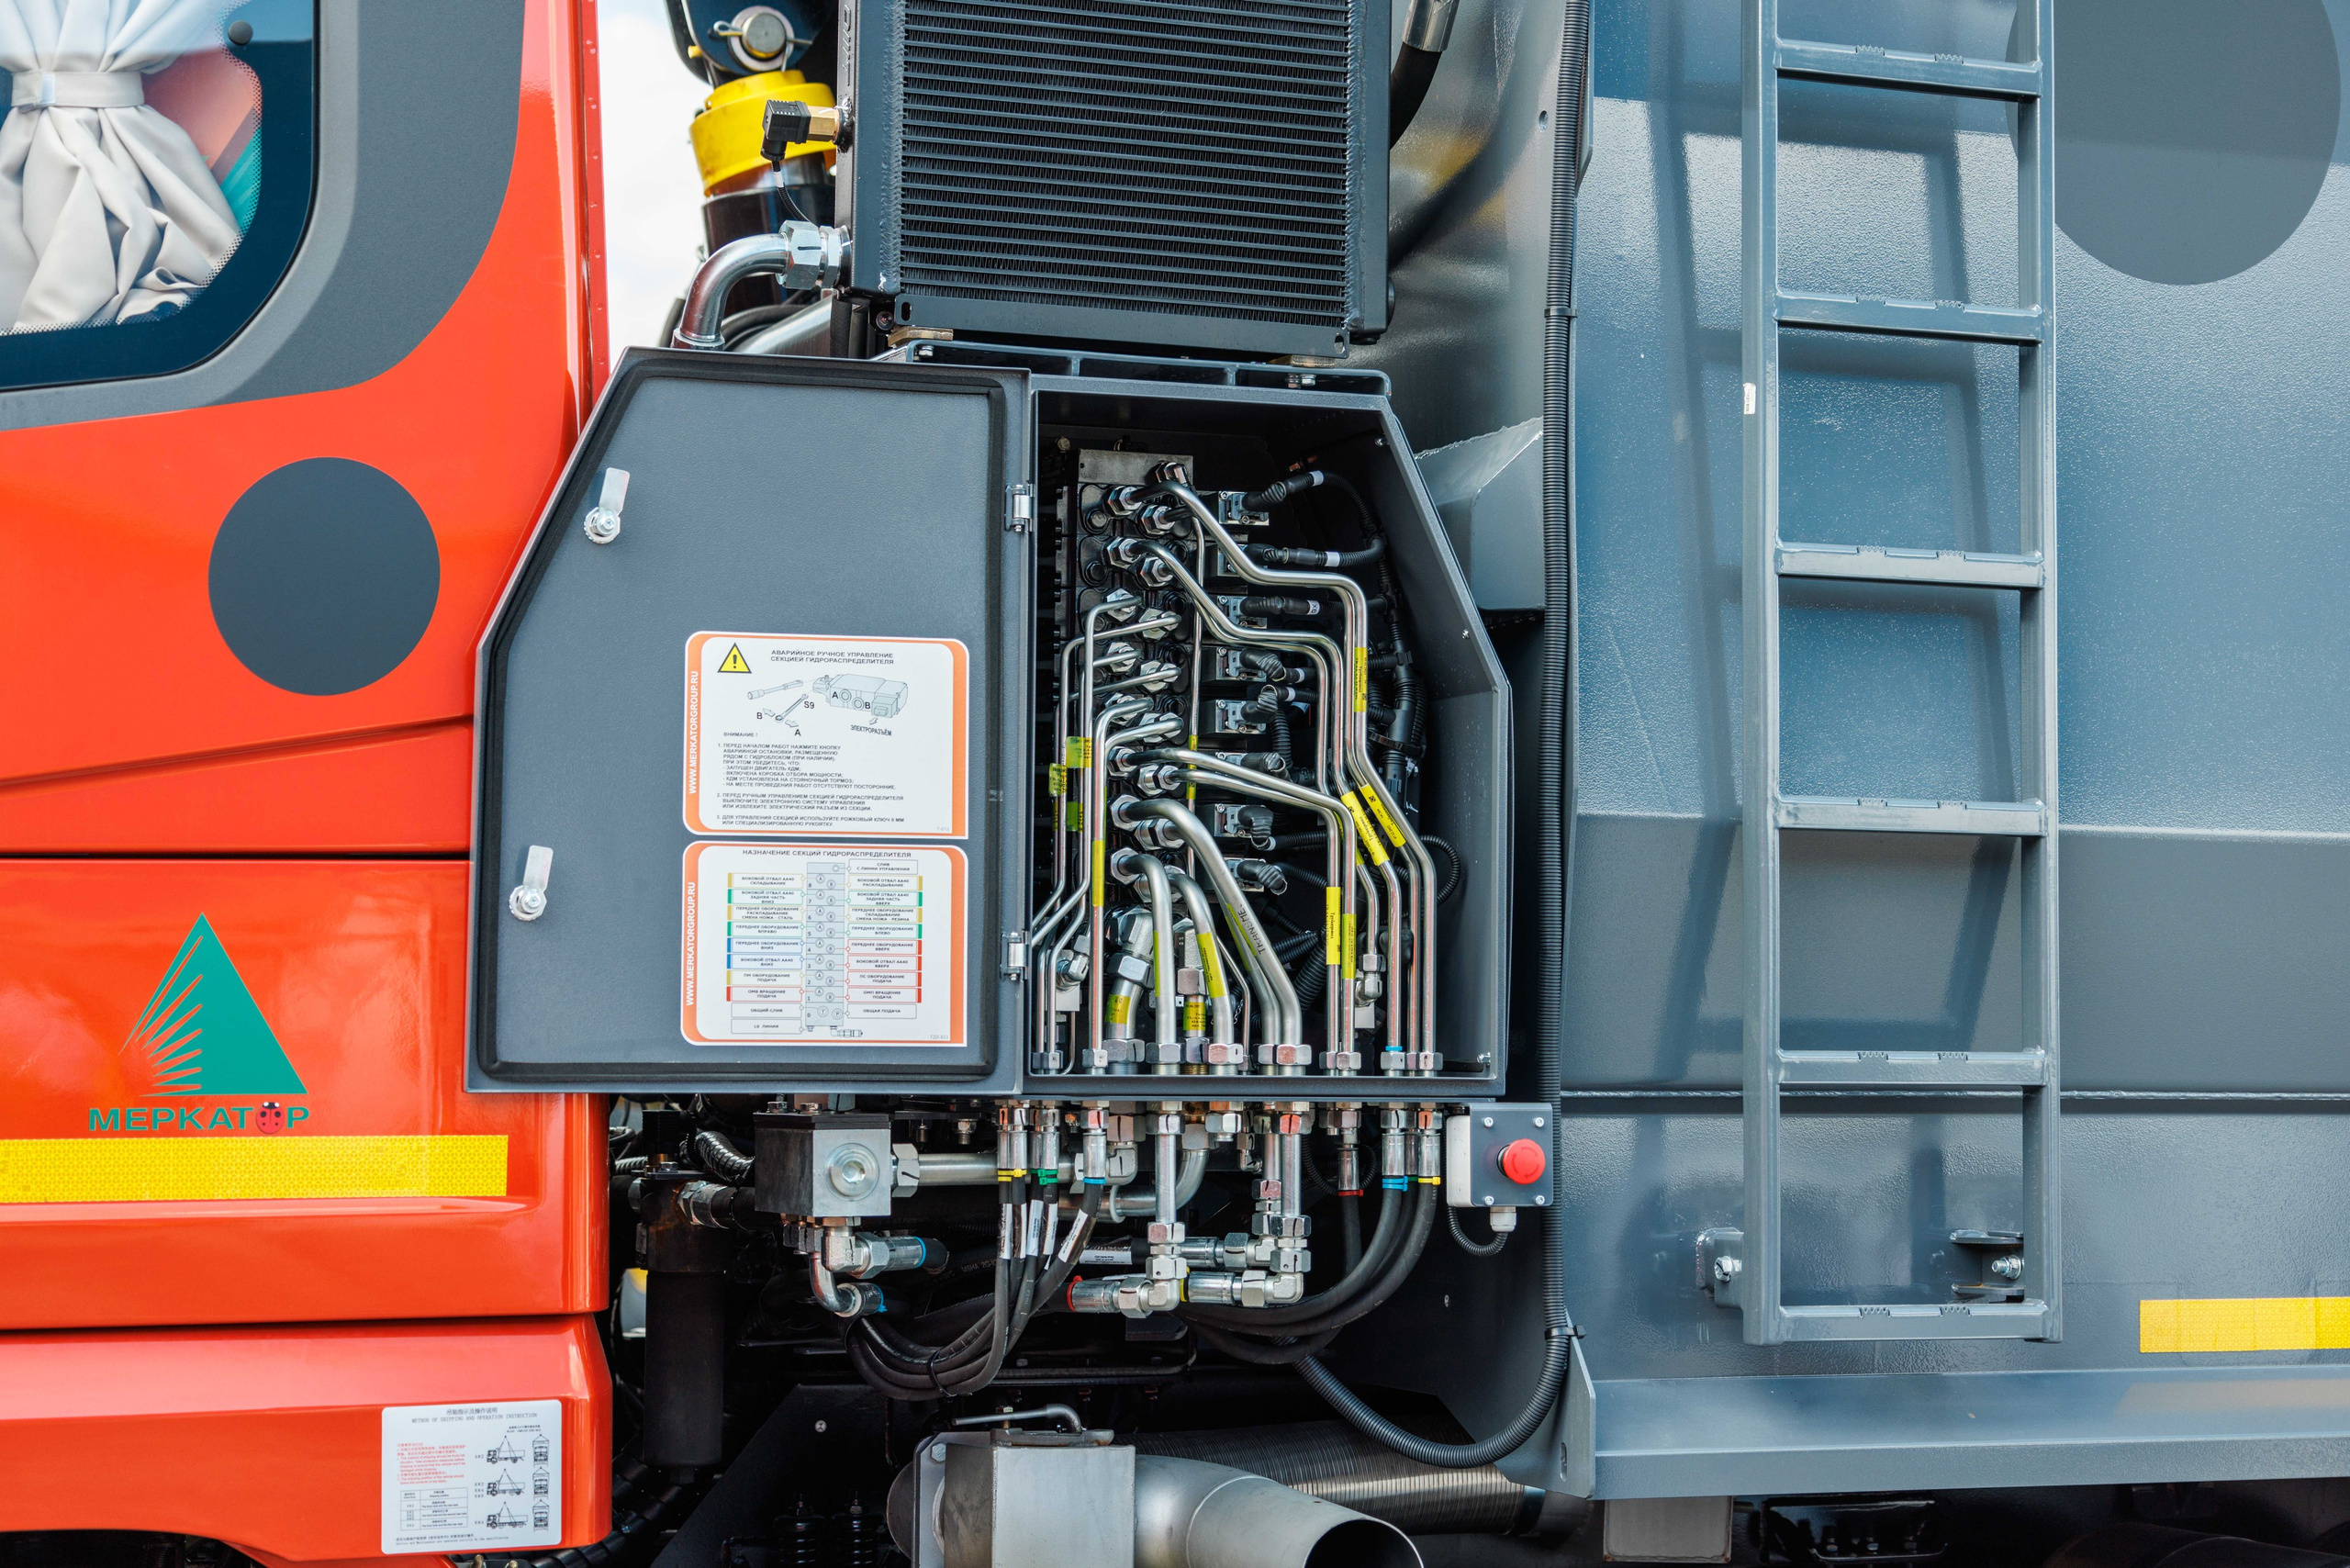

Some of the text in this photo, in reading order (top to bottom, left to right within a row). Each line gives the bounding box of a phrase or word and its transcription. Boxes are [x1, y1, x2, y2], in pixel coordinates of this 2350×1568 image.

[688, 671, 699, 794] WWW.MERKATORGROUP.RU
[850, 725, 892, 736] ЭЛЕКТРОРАЗЪЁМ
[686, 882, 696, 1006] WWW.MERKATORGROUP.RU
